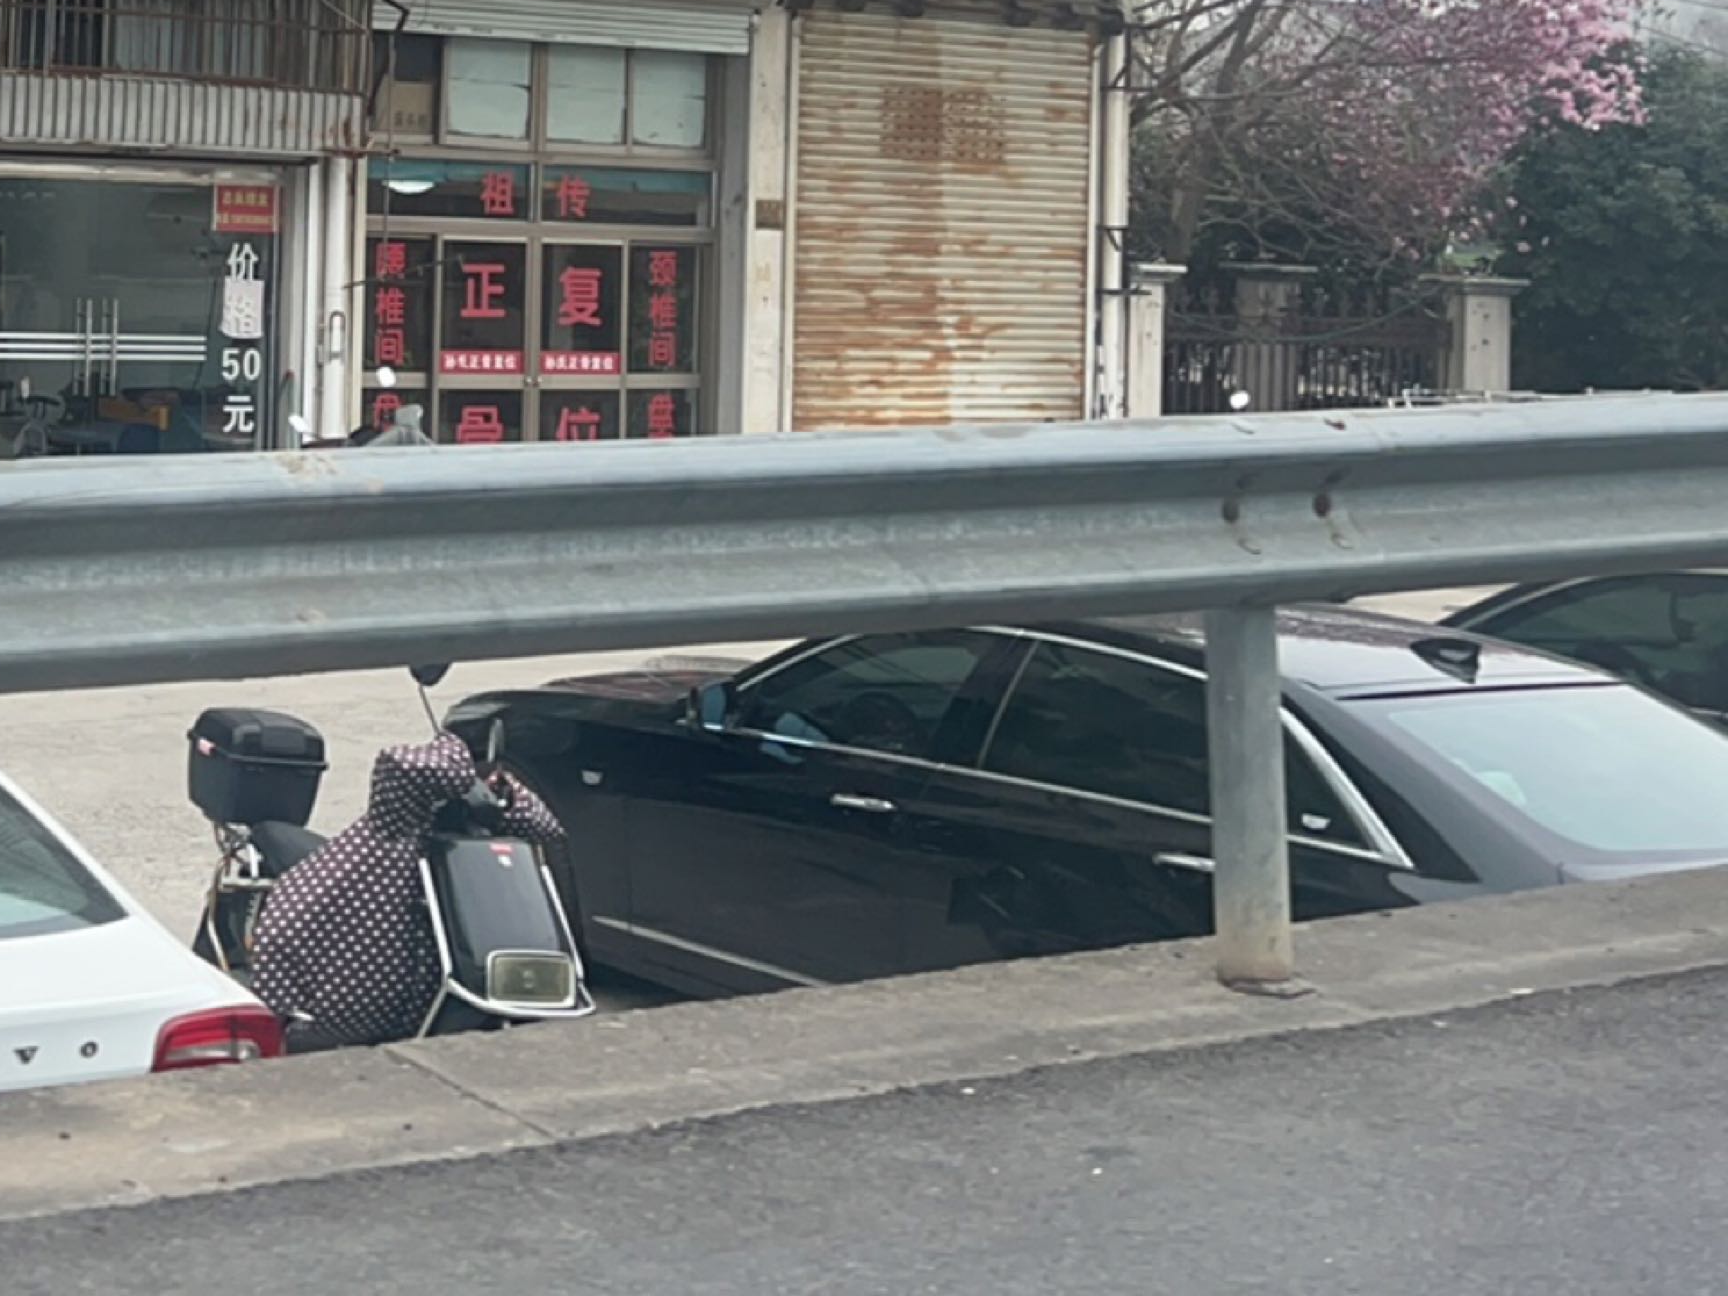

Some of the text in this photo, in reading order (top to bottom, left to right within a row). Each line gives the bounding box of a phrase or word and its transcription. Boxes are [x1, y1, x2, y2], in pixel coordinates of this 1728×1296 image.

[481, 172, 591, 219] 祖传
[460, 263, 506, 319] 正
[558, 265, 604, 326] 复
